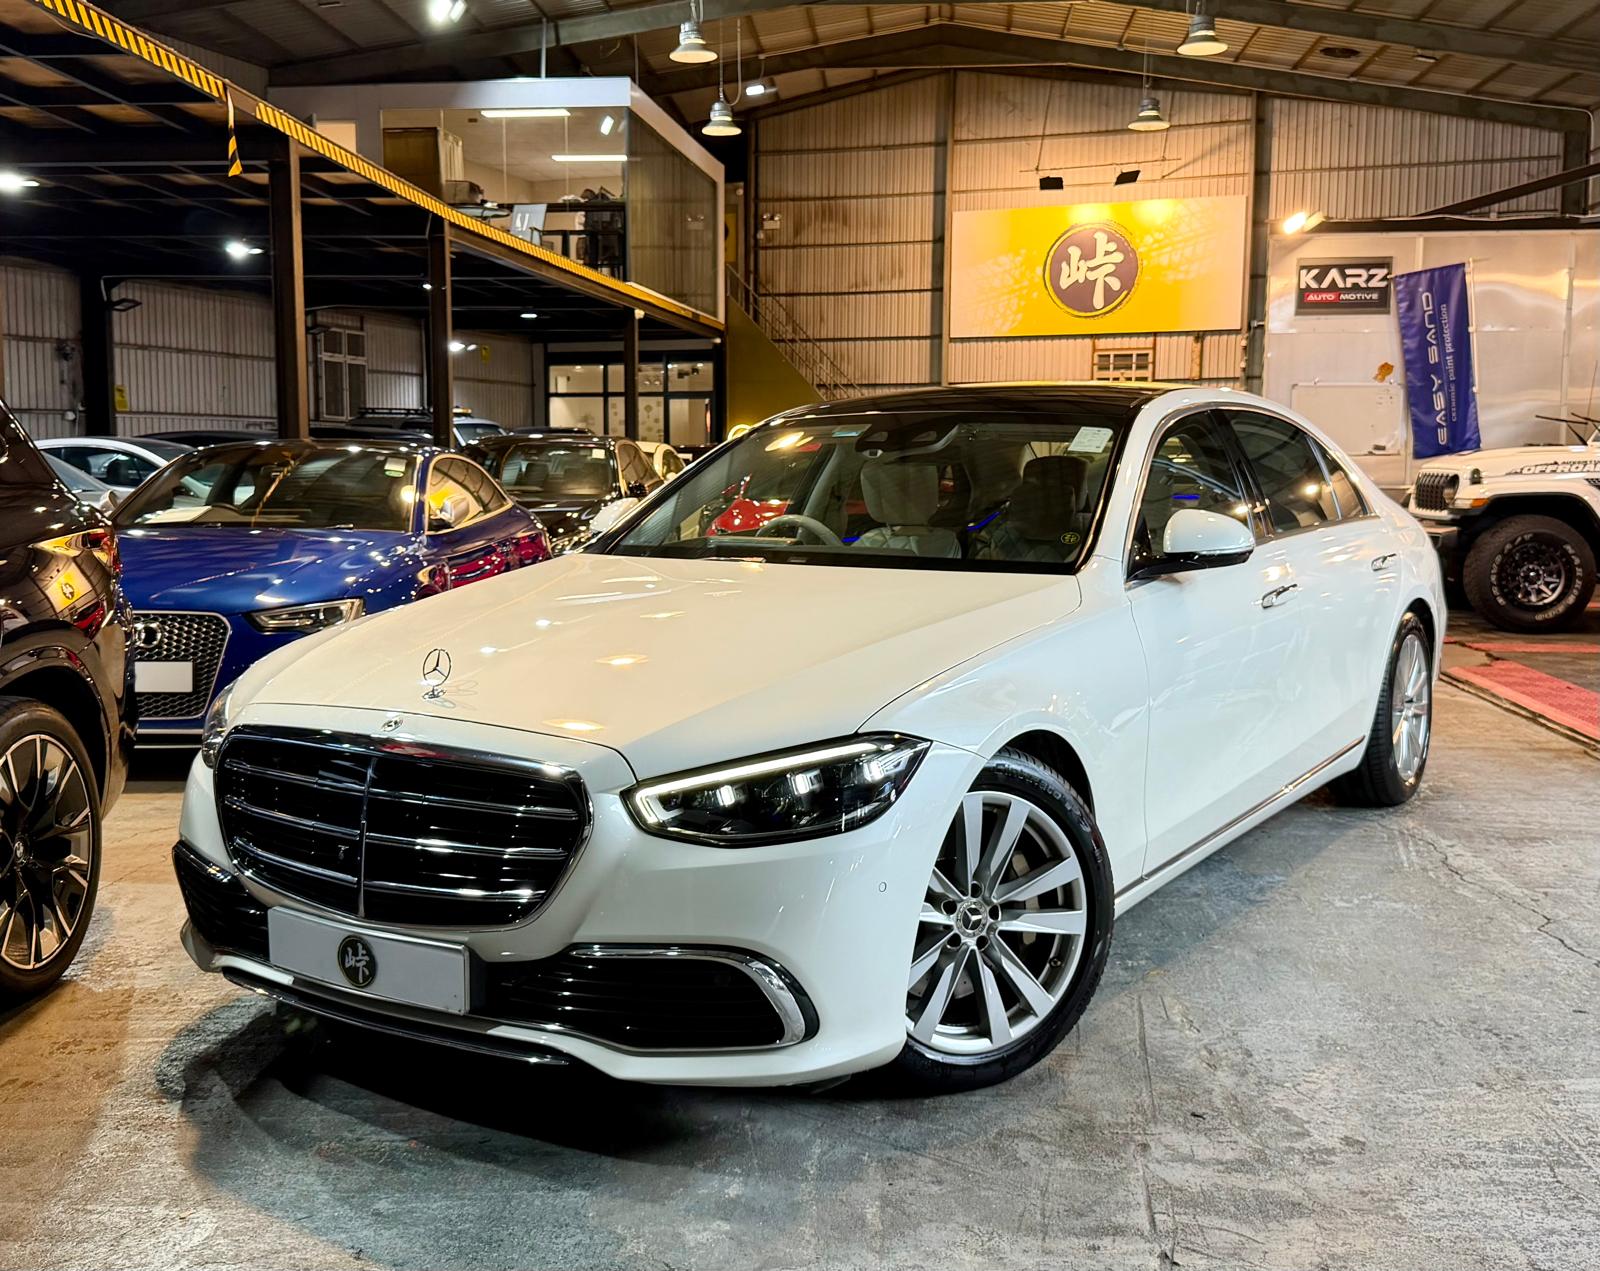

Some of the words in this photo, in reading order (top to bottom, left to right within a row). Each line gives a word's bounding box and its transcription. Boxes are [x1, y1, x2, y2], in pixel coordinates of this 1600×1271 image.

[1059, 231, 1125, 310] 峠
[1299, 267, 1389, 289] KARZ
[1306, 293, 1336, 301] AUTO
[1339, 292, 1379, 300] MOTIVE
[1421, 291, 1440, 365] SAND
[1440, 303, 1455, 354] protection
[1444, 355, 1457, 381] paint
[1430, 373, 1448, 446] EASY
[1448, 383, 1458, 423] ceramic
[1521, 463, 1600, 475] OFFROA
[344, 942, 371, 984] 峠
